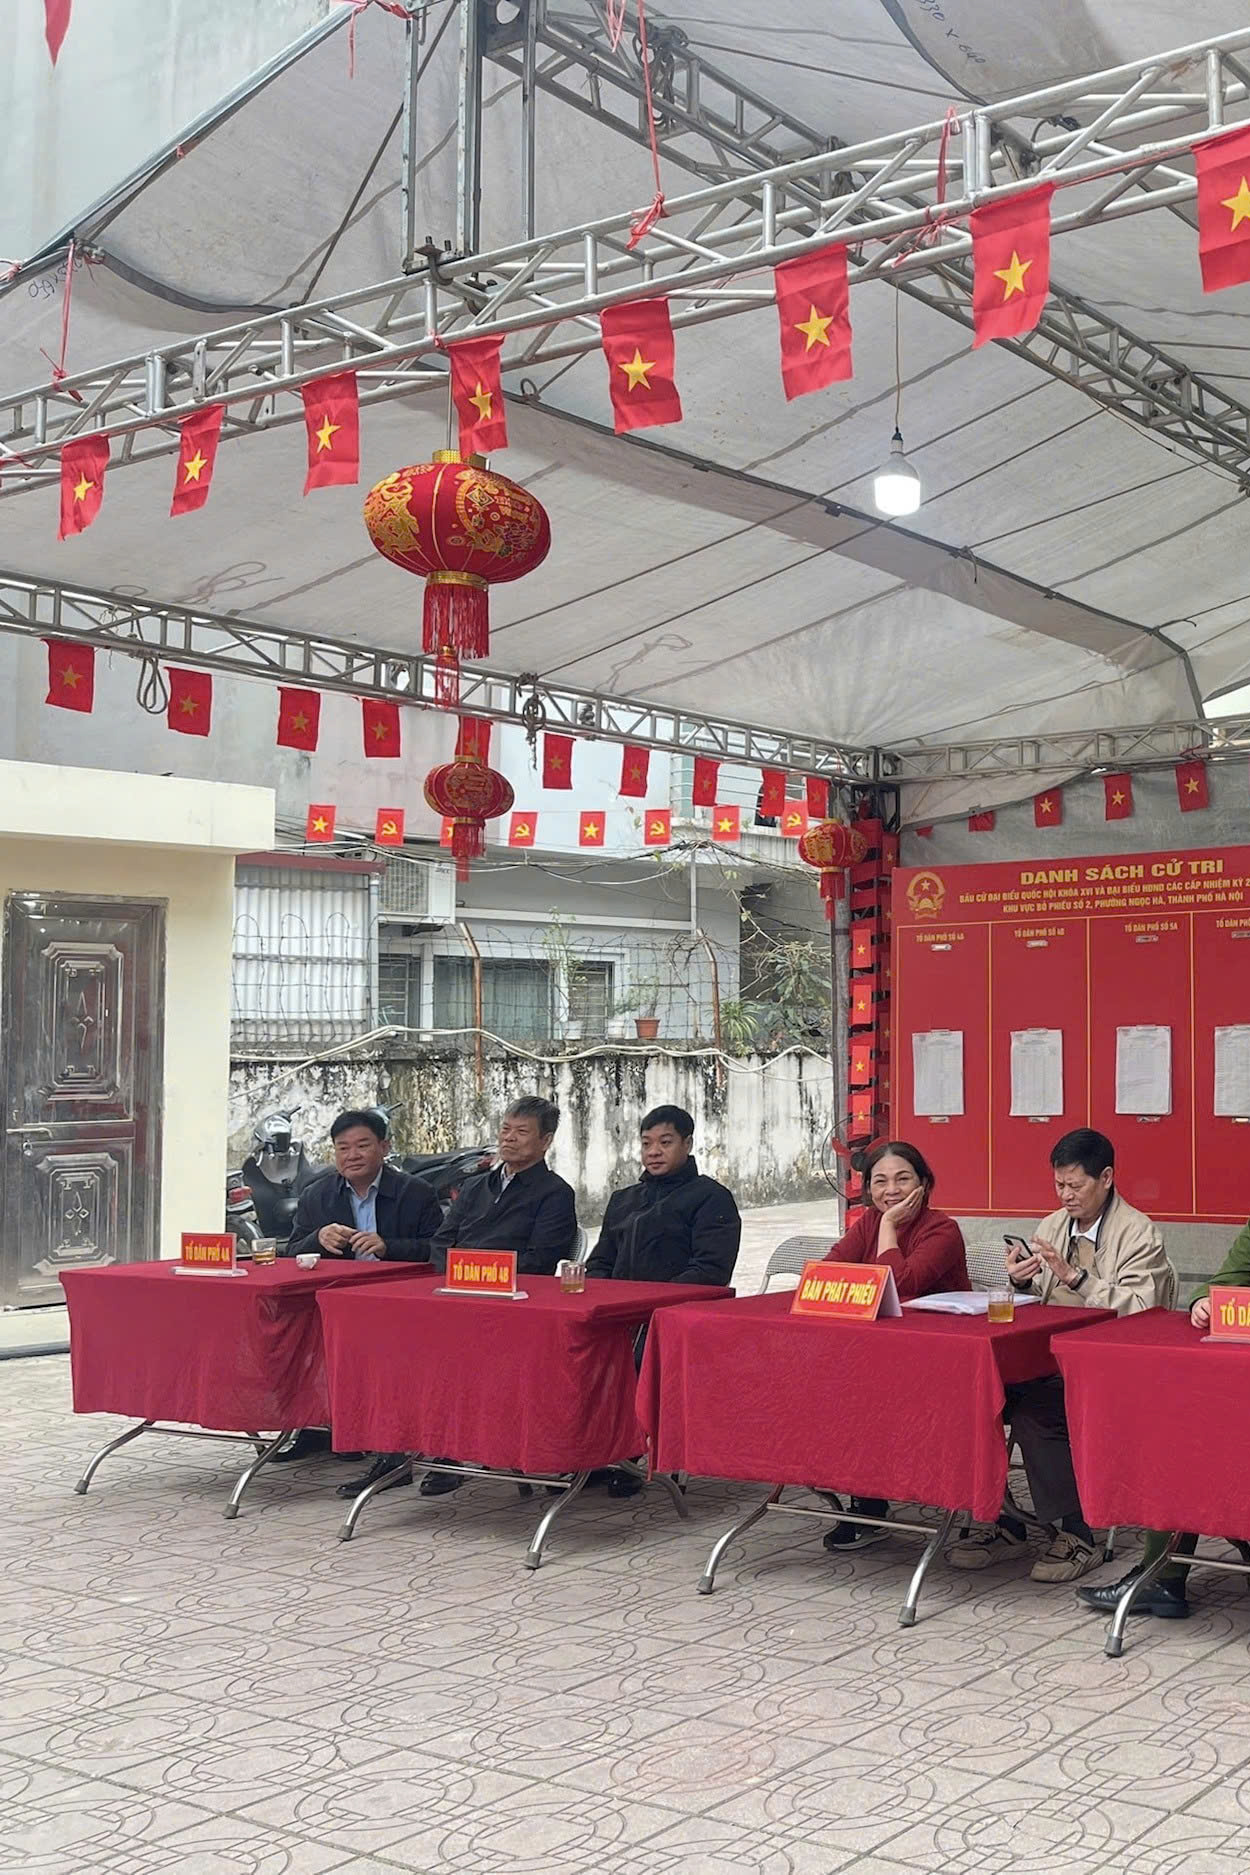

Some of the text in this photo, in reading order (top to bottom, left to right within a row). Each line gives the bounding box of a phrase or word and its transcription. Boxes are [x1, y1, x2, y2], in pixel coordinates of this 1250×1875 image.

[1020, 858, 1223, 885] DANH SÁCH CỬ TRI
[1021, 888, 1042, 900] QUỐC
[1043, 888, 1057, 900] HỘI
[1080, 887, 1094, 897] XVI
[1094, 885, 1105, 896] VÀ
[1107, 885, 1120, 896] ĐẠI
[1166, 881, 1182, 891] CÁC
[1184, 879, 1201, 890] CẤP
[1232, 877, 1243, 887] KỲ
[1003, 903, 1018, 913] KHU
[1073, 899, 1084, 910] SỐ
[1129, 897, 1151, 907] NGỌC
[1168, 893, 1194, 904] THÀNH
[1196, 891, 1213, 903] PHỐ
[1215, 891, 1227, 902] HÀ
[1228, 890, 1243, 902] NỘI
[194, 1243, 207, 1261] DÂN
[207, 1241, 221, 1261] PHỐ
[464, 1261, 480, 1282] DÂN
[481, 1261, 499, 1283] PHỐ
[499, 1265, 510, 1283] 4B
[822, 1277, 849, 1304] PHÁT
[846, 1278, 878, 1306] PHIẾU
